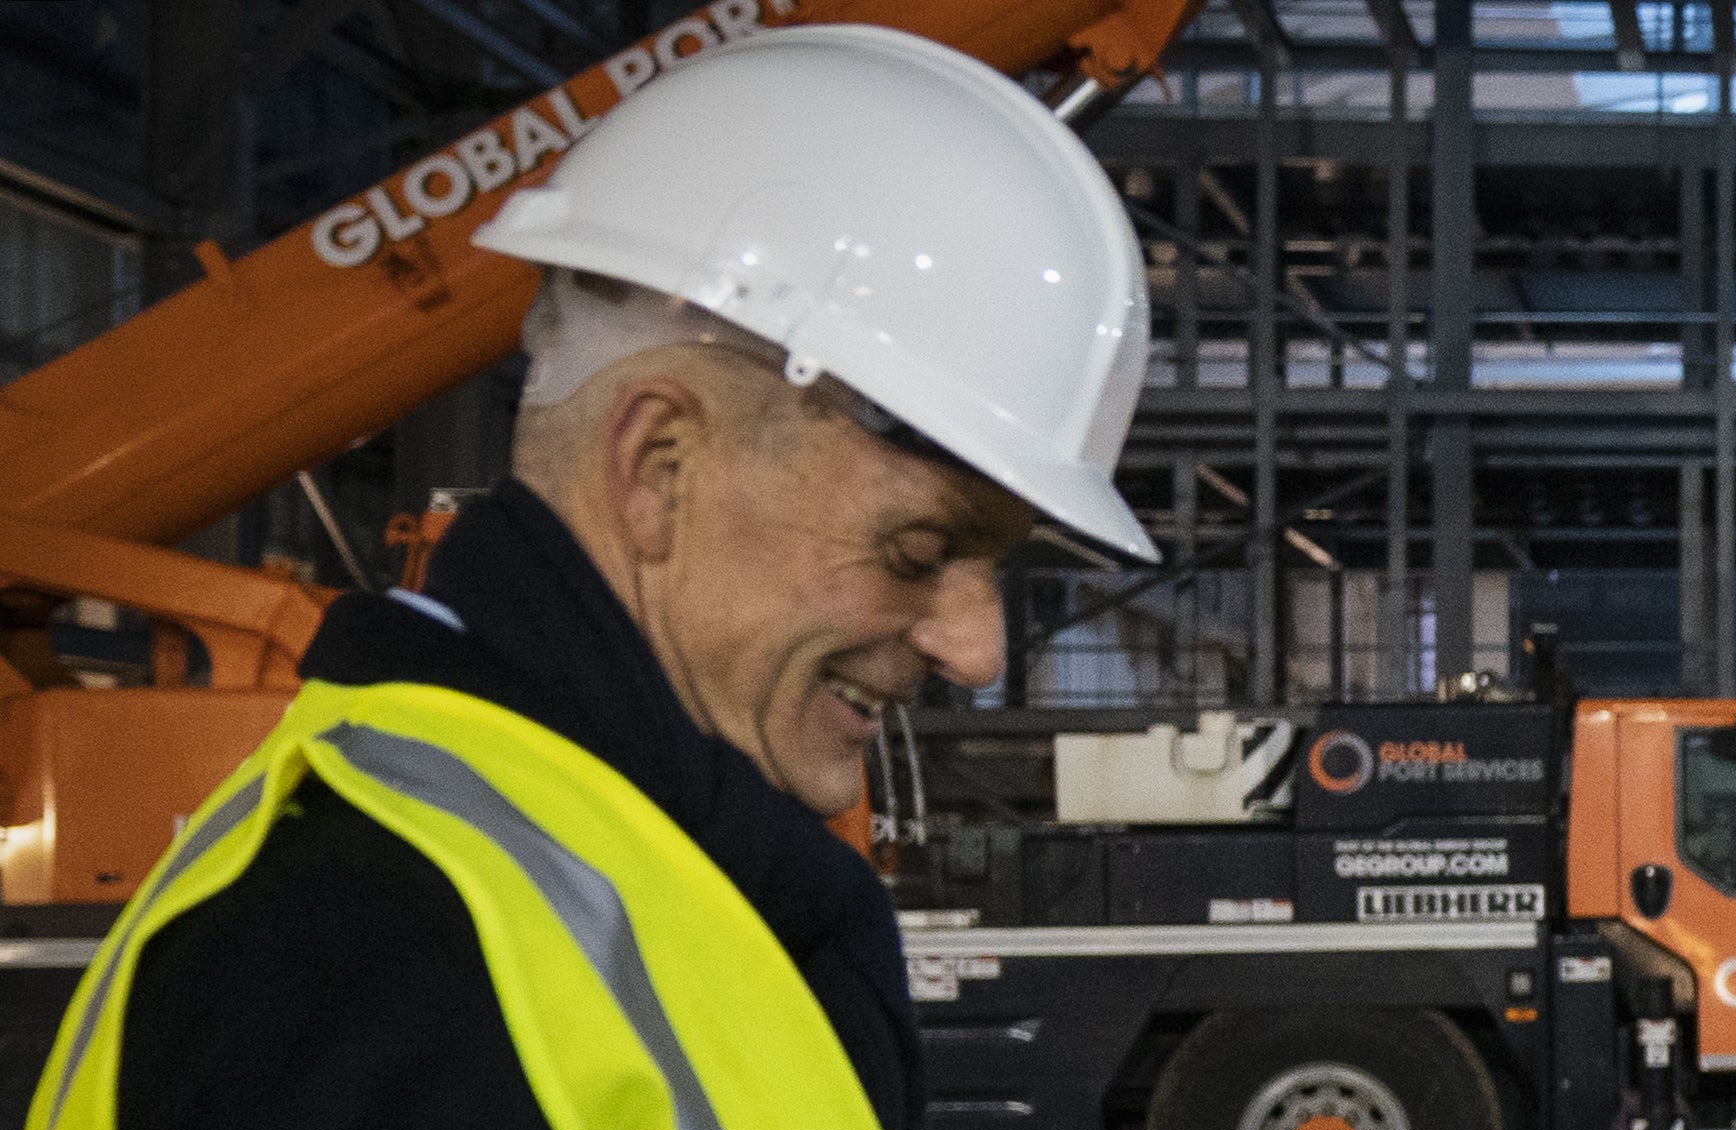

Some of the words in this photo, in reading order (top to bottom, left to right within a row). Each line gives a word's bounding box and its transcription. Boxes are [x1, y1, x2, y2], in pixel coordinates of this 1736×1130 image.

[310, 88, 601, 268] GLOBAL
[605, 0, 795, 98] POR
[1379, 741, 1468, 764] GLOBAL
[1379, 761, 1437, 782] PORT
[1442, 758, 1545, 782] SERVICES
[1361, 889, 1539, 917] LIEBHERR
